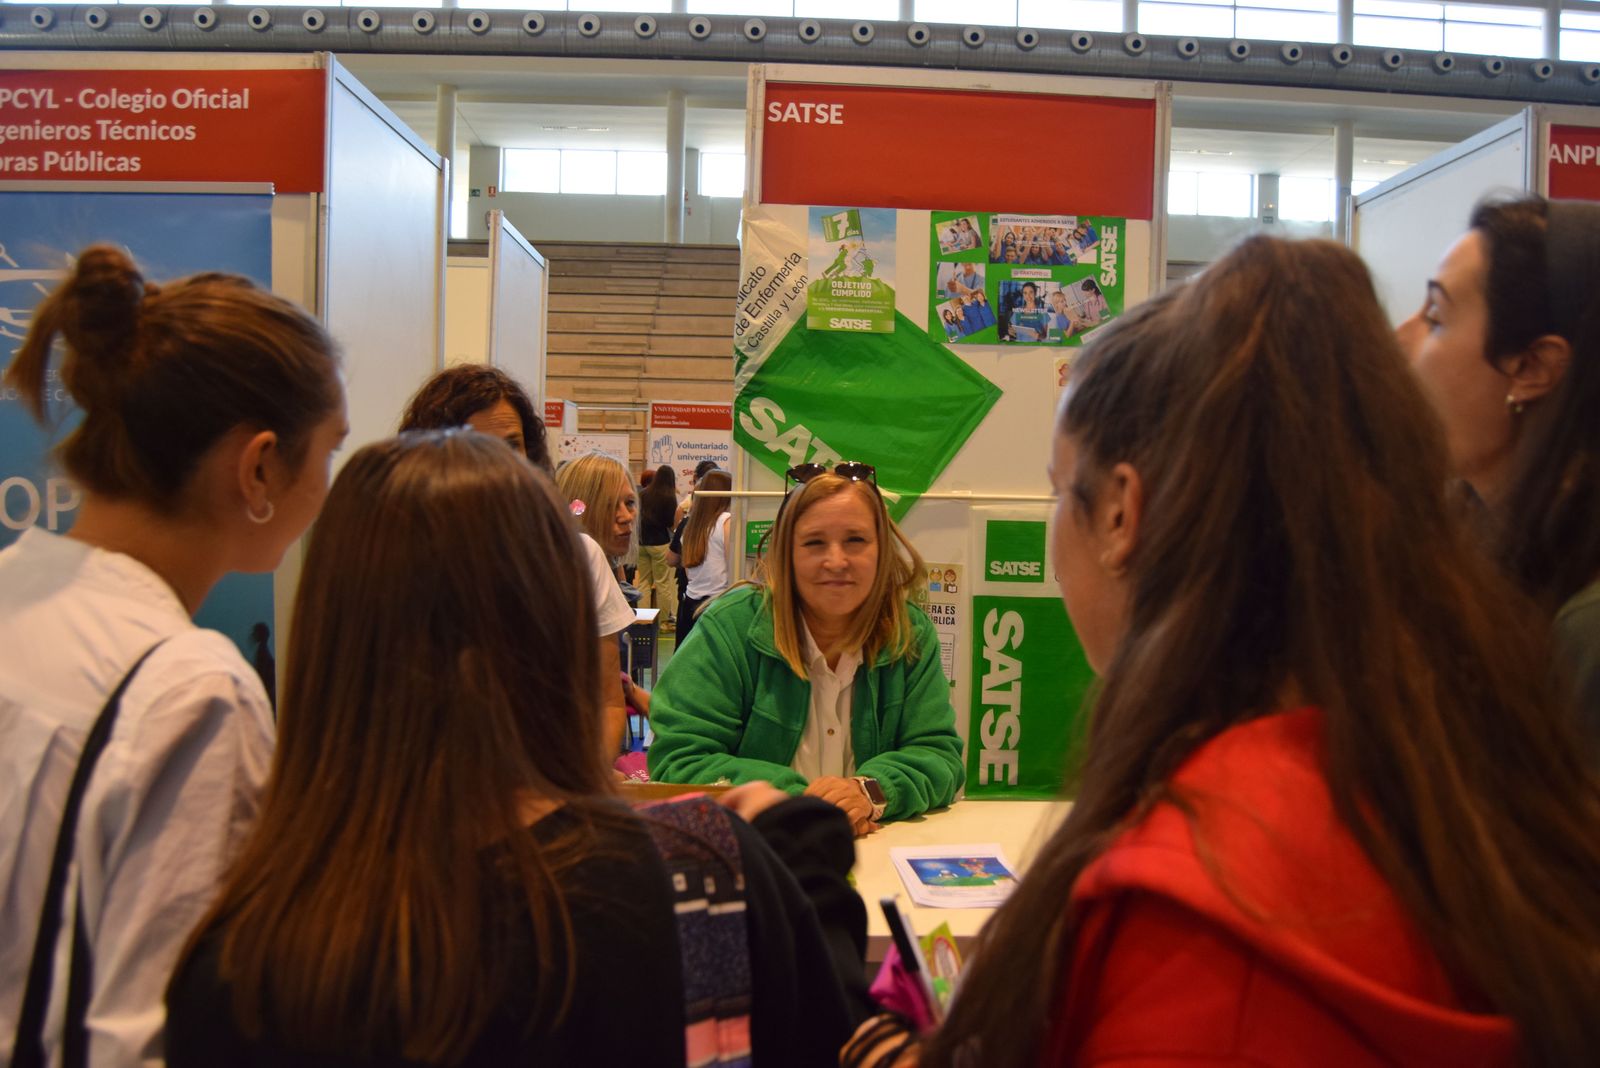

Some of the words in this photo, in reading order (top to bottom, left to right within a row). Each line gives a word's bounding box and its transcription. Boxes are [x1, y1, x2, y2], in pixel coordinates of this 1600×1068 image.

[0, 88, 59, 109] PCYL
[79, 88, 166, 113] Colegio
[172, 86, 249, 109] Oficial
[767, 101, 844, 125] SATSE
[97, 118, 196, 141] Técnicos
[44, 150, 141, 172] Públicas
[832, 211, 849, 239] 7
[1100, 225, 1118, 287] SATSE
[735, 318, 750, 337] de
[744, 251, 802, 318] Enfermería
[784, 273, 808, 301] León
[831, 280, 872, 290] OBJETIVO
[831, 289, 872, 298] CUMPLIDO
[779, 299, 790, 313] y
[747, 308, 782, 349] Castilla
[829, 318, 872, 330] SATSE
[676, 441, 729, 450] Voluntariado
[677, 453, 729, 462] universitario
[990, 560, 1041, 576] SATSE
[945, 605, 956, 615] ES
[979, 607, 1025, 786] SATSE
